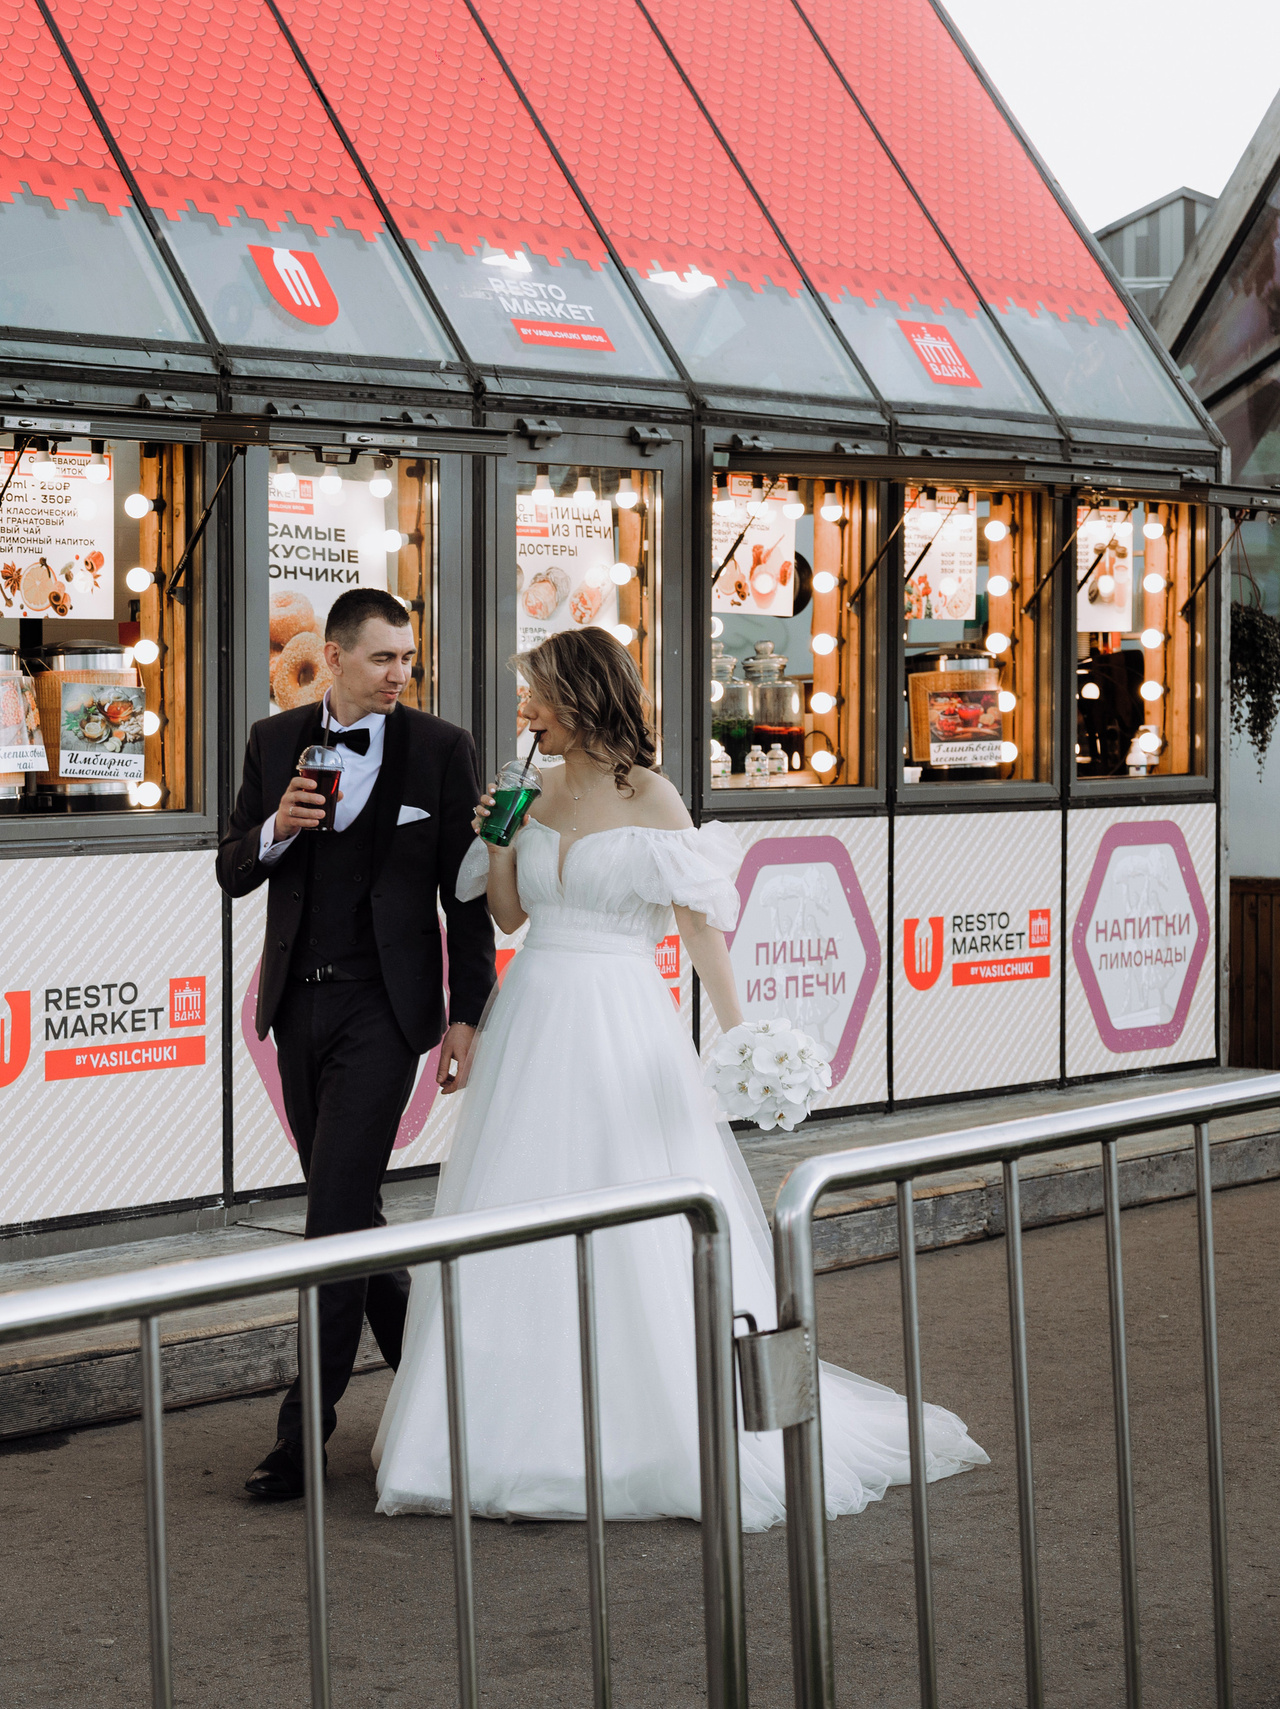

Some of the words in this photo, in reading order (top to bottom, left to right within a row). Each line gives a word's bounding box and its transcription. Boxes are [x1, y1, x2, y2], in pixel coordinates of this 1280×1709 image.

[488, 277, 567, 301] RESTO
[499, 297, 595, 321] MARKET
[520, 327, 532, 335] BY
[532, 329, 581, 340] VASILCHUKI
[581, 333, 607, 343] BROS.
[929, 363, 971, 379] ВДНХ
[40, 494, 72, 504] 350₽
[6, 515, 65, 526] ГРАНАТОВЫЙ
[550, 507, 601, 524] ПИЦЦА
[23, 525, 41, 535] ЧАЙ
[269, 522, 346, 542] САМЫЕ
[551, 523, 571, 537] ИЗ
[575, 524, 613, 539] ПЕЧИ
[16, 546, 43, 554] ПУНШ
[55, 538, 95, 546] НАПИТОК
[269, 543, 359, 564] КУСНЫЕ
[269, 564, 360, 584] ОНЧИКИ
[933, 742, 1002, 753] Глинтвейн
[17, 759, 34, 770] чай
[67, 752, 138, 770] Имбирно-
[61, 766, 119, 777] лимонный
[124, 769, 142, 779] чай
[952, 912, 1010, 933] RESTO
[1096, 913, 1190, 943] НАПИТКИ
[952, 932, 1026, 955] MARKET
[1031, 934, 1049, 944] ВДНХ
[756, 937, 839, 967] ПИЦЦА
[1099, 946, 1187, 971] ЛИМОНАДЫ
[970, 966, 978, 975] BY
[979, 962, 1034, 978] VASILCHUKI
[747, 977, 776, 1003] ИЗ
[785, 971, 846, 999] ПЕЧИ
[45, 981, 138, 1012] RESTO
[45, 1007, 165, 1041] MARKET
[174, 1009, 201, 1022] ВДНХ
[75, 1054, 87, 1065] BY
[89, 1045, 177, 1068] VASILCHUKI
